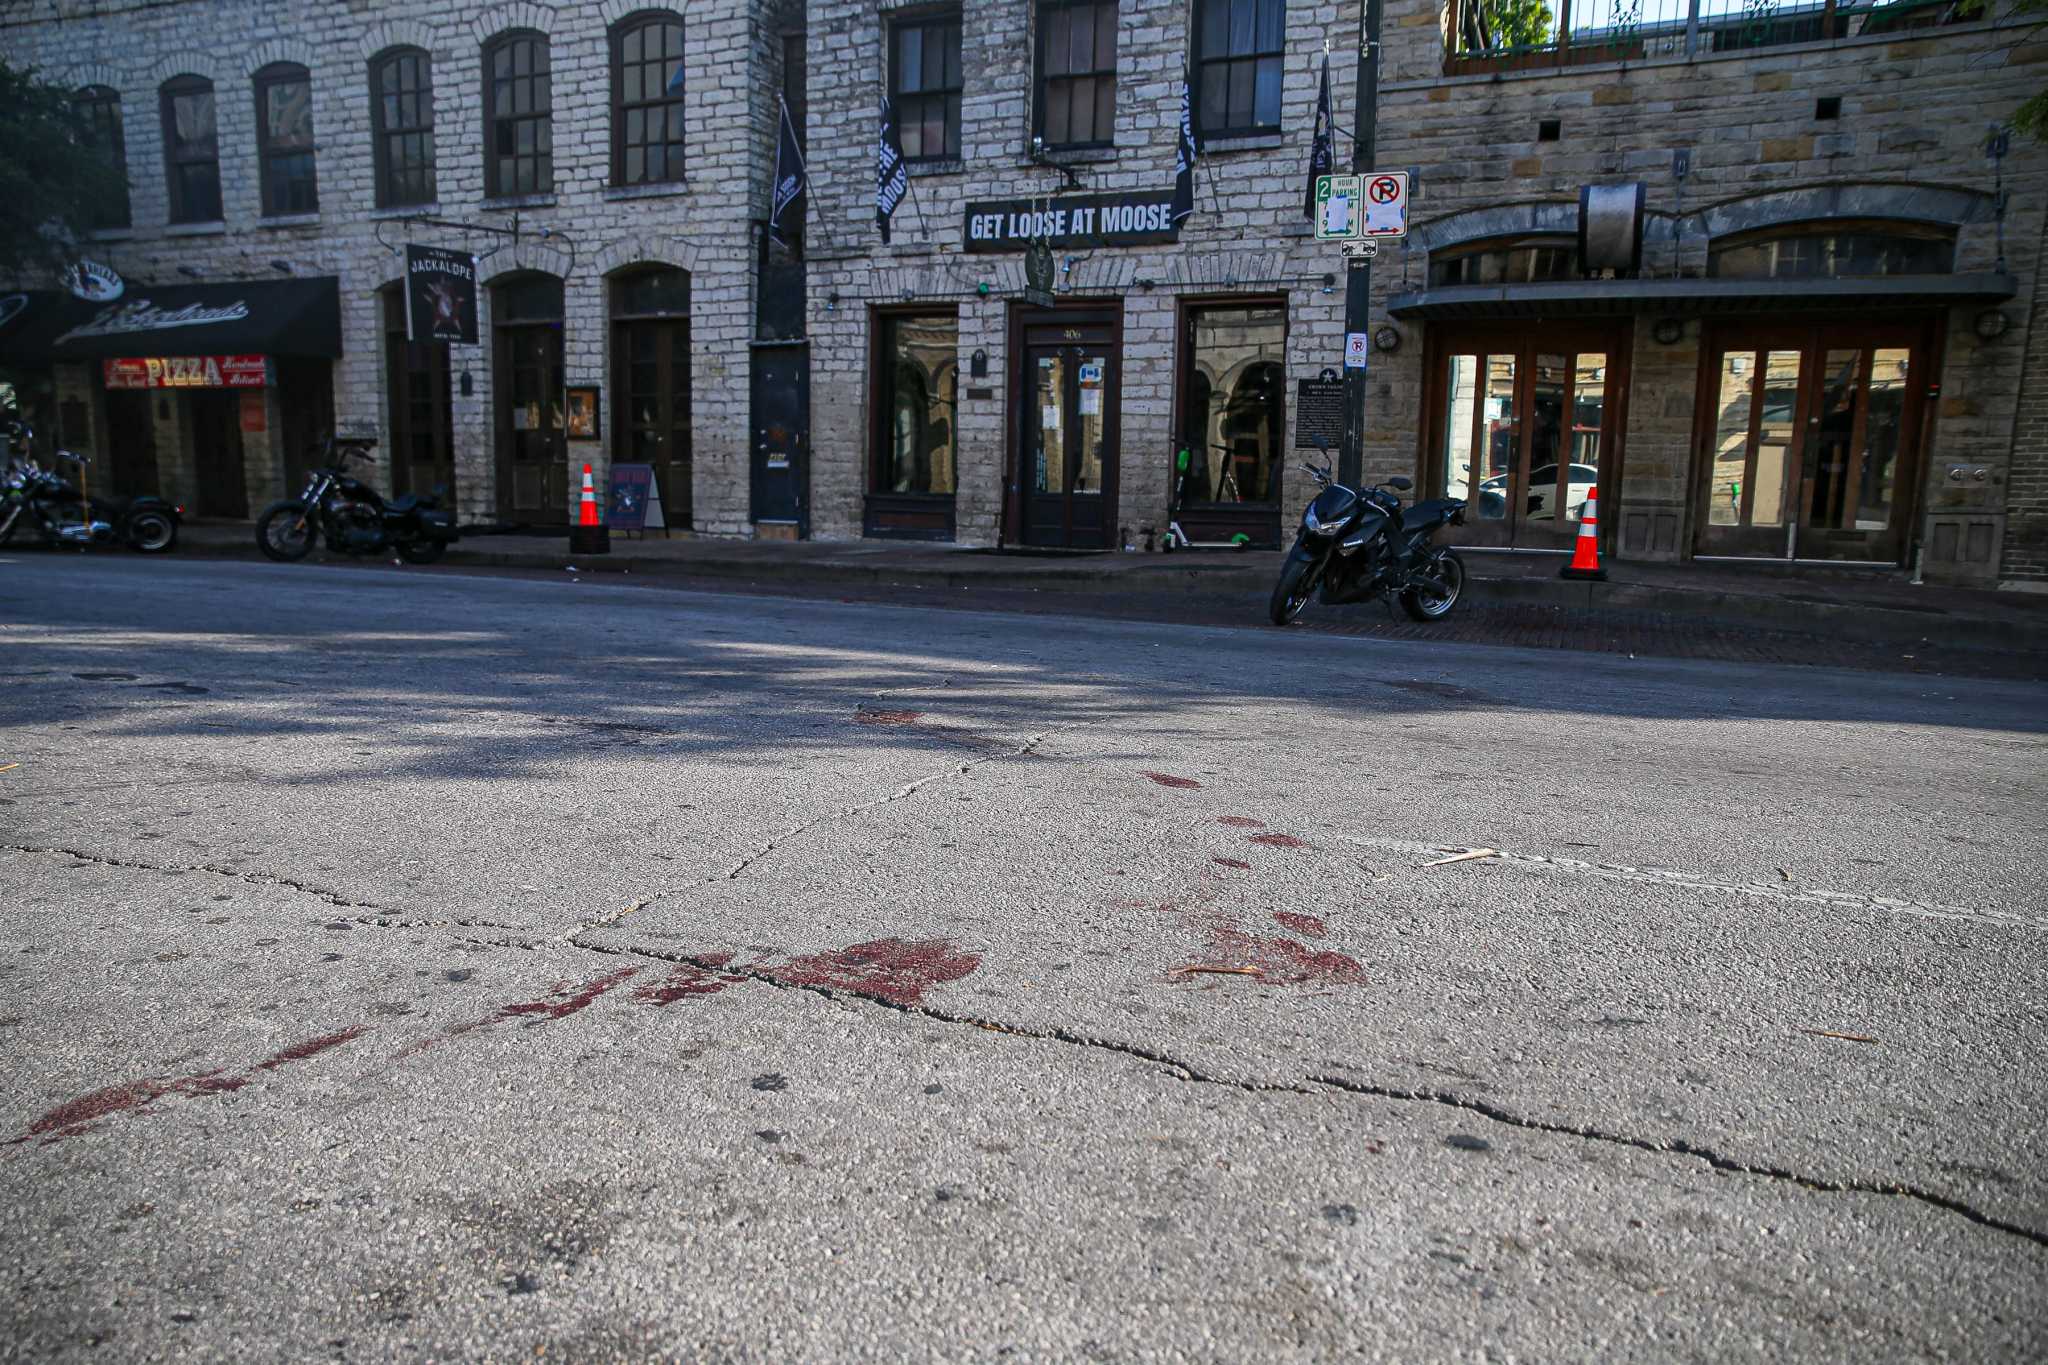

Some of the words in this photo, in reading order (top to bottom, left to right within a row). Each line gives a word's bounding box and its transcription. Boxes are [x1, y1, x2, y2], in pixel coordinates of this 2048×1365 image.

[1319, 181, 1329, 198] 2
[1332, 188, 1358, 197] PARKING
[1337, 179, 1353, 187] HOUR
[971, 213, 1004, 240] GET
[1008, 209, 1066, 238] LOOSE
[1071, 208, 1096, 235] AT
[1101, 204, 1172, 234] MOOSE
[411, 259, 472, 280] JACKALOPE
[146, 356, 223, 387] PIZZA
